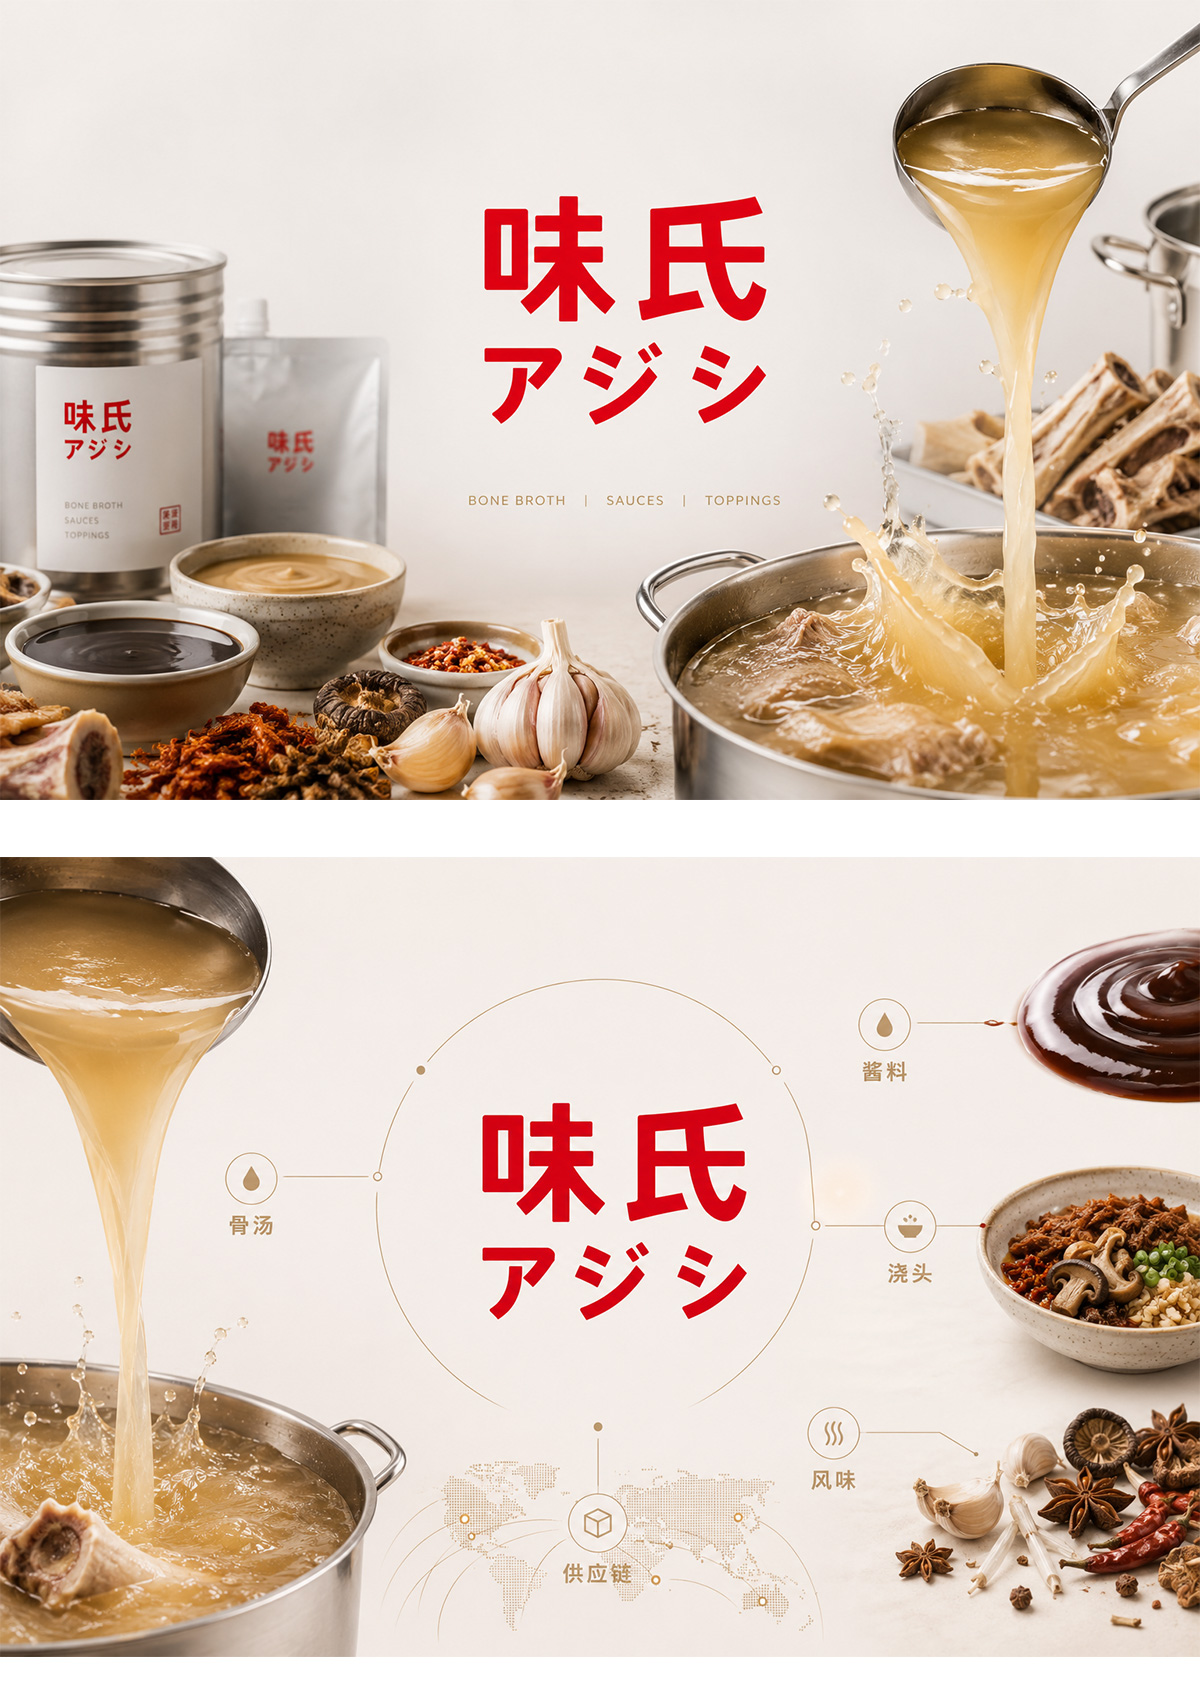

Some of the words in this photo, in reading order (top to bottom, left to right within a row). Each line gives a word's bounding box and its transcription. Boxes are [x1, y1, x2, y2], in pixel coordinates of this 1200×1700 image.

[64, 400, 132, 434] 味氏
[64, 439, 132, 460] アジシ
[65, 501, 89, 510] BONE
[92, 501, 123, 510] BROTH
[65, 516, 99, 525] SAUCES
[65, 531, 109, 539] TOPPINGS
